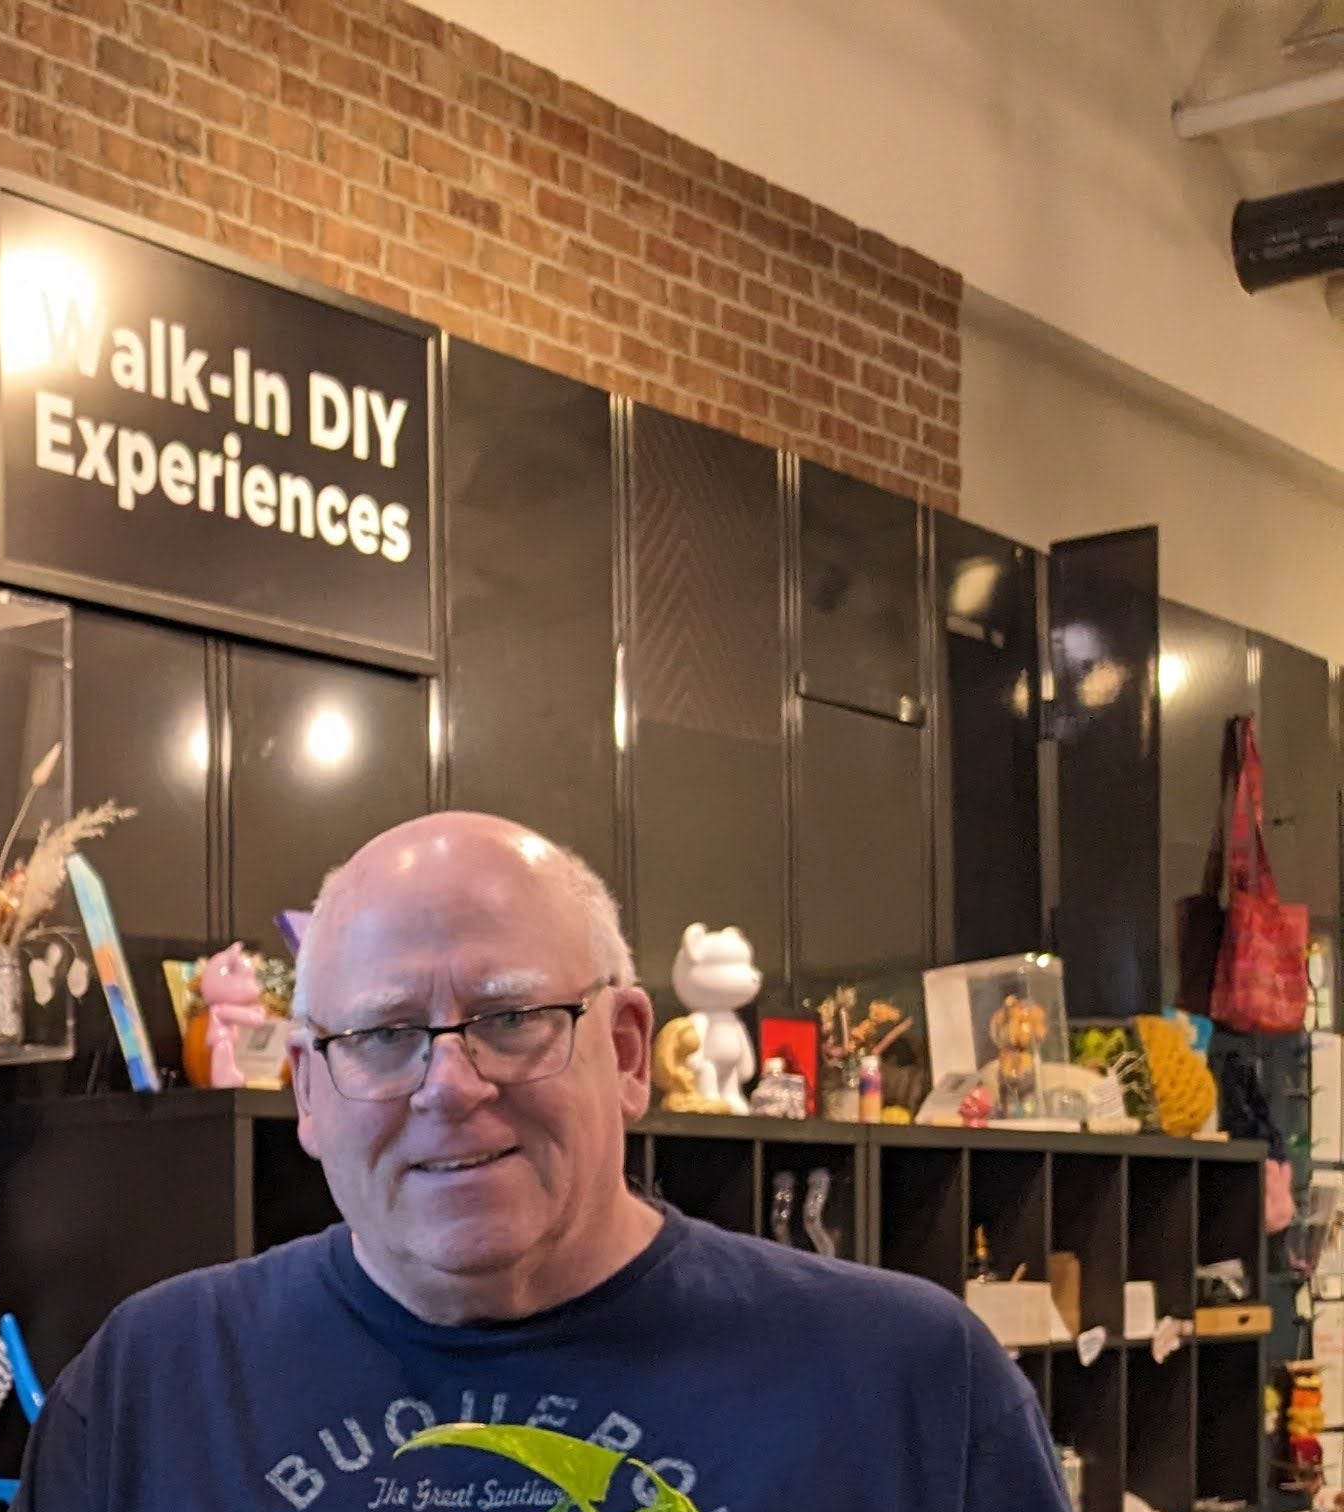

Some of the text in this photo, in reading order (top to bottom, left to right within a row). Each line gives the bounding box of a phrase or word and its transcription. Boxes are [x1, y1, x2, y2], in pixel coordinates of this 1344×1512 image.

[37, 285, 409, 469] Walk-In DIY
[34, 390, 412, 563] Experiences
[368, 1477, 566, 1511] The Great Southw
